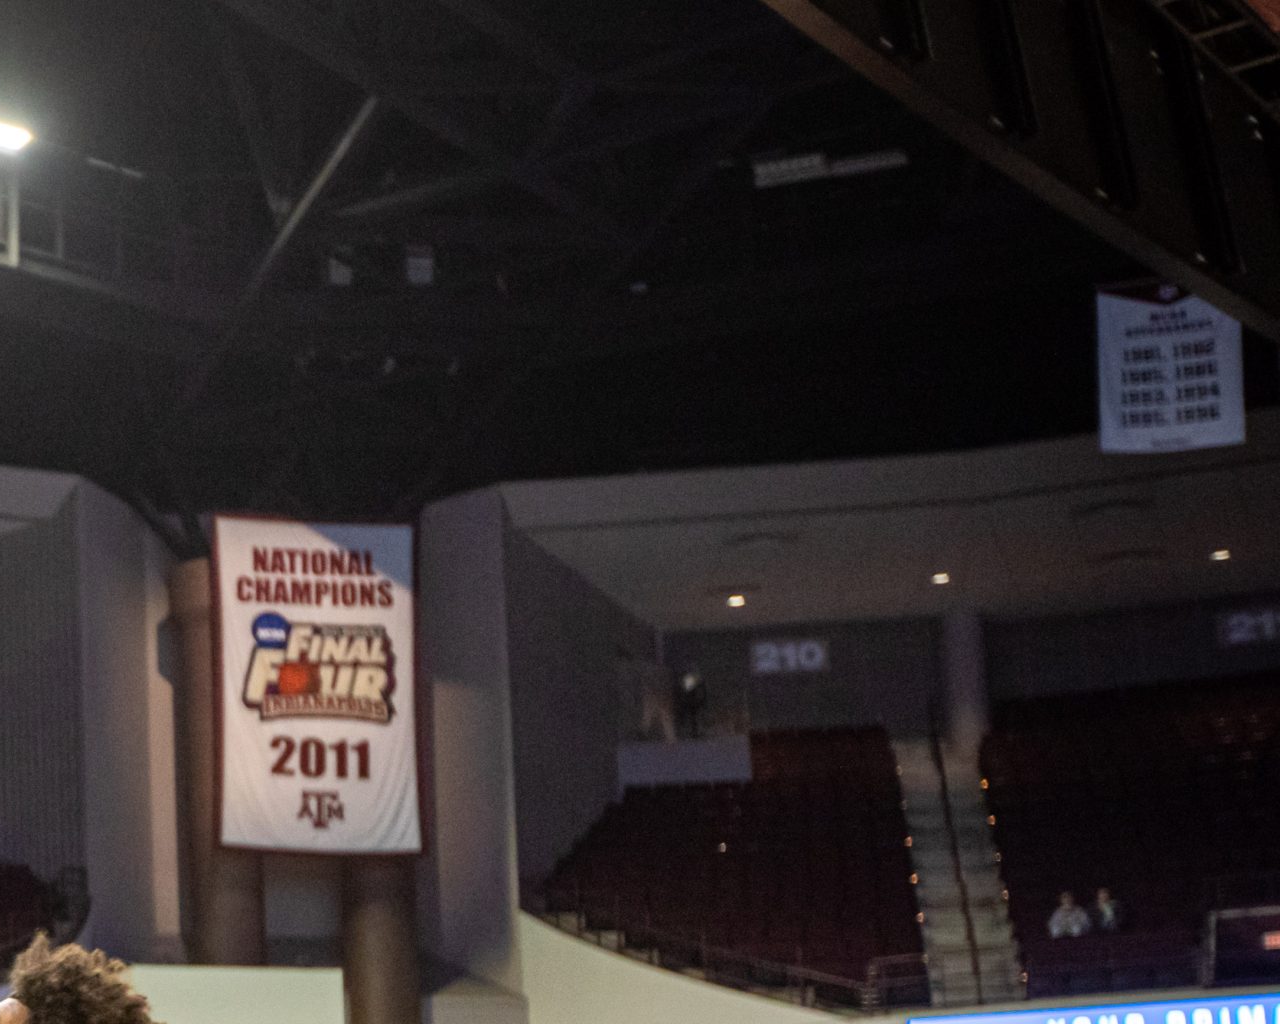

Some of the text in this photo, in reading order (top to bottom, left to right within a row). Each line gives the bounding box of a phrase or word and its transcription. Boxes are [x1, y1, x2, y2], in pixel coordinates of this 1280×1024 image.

[252, 547, 376, 576] NATIONAL
[236, 576, 394, 607] CHAMPIONS
[286, 624, 388, 663] FINAL
[754, 642, 823, 673] 210
[270, 735, 371, 779] 2011
